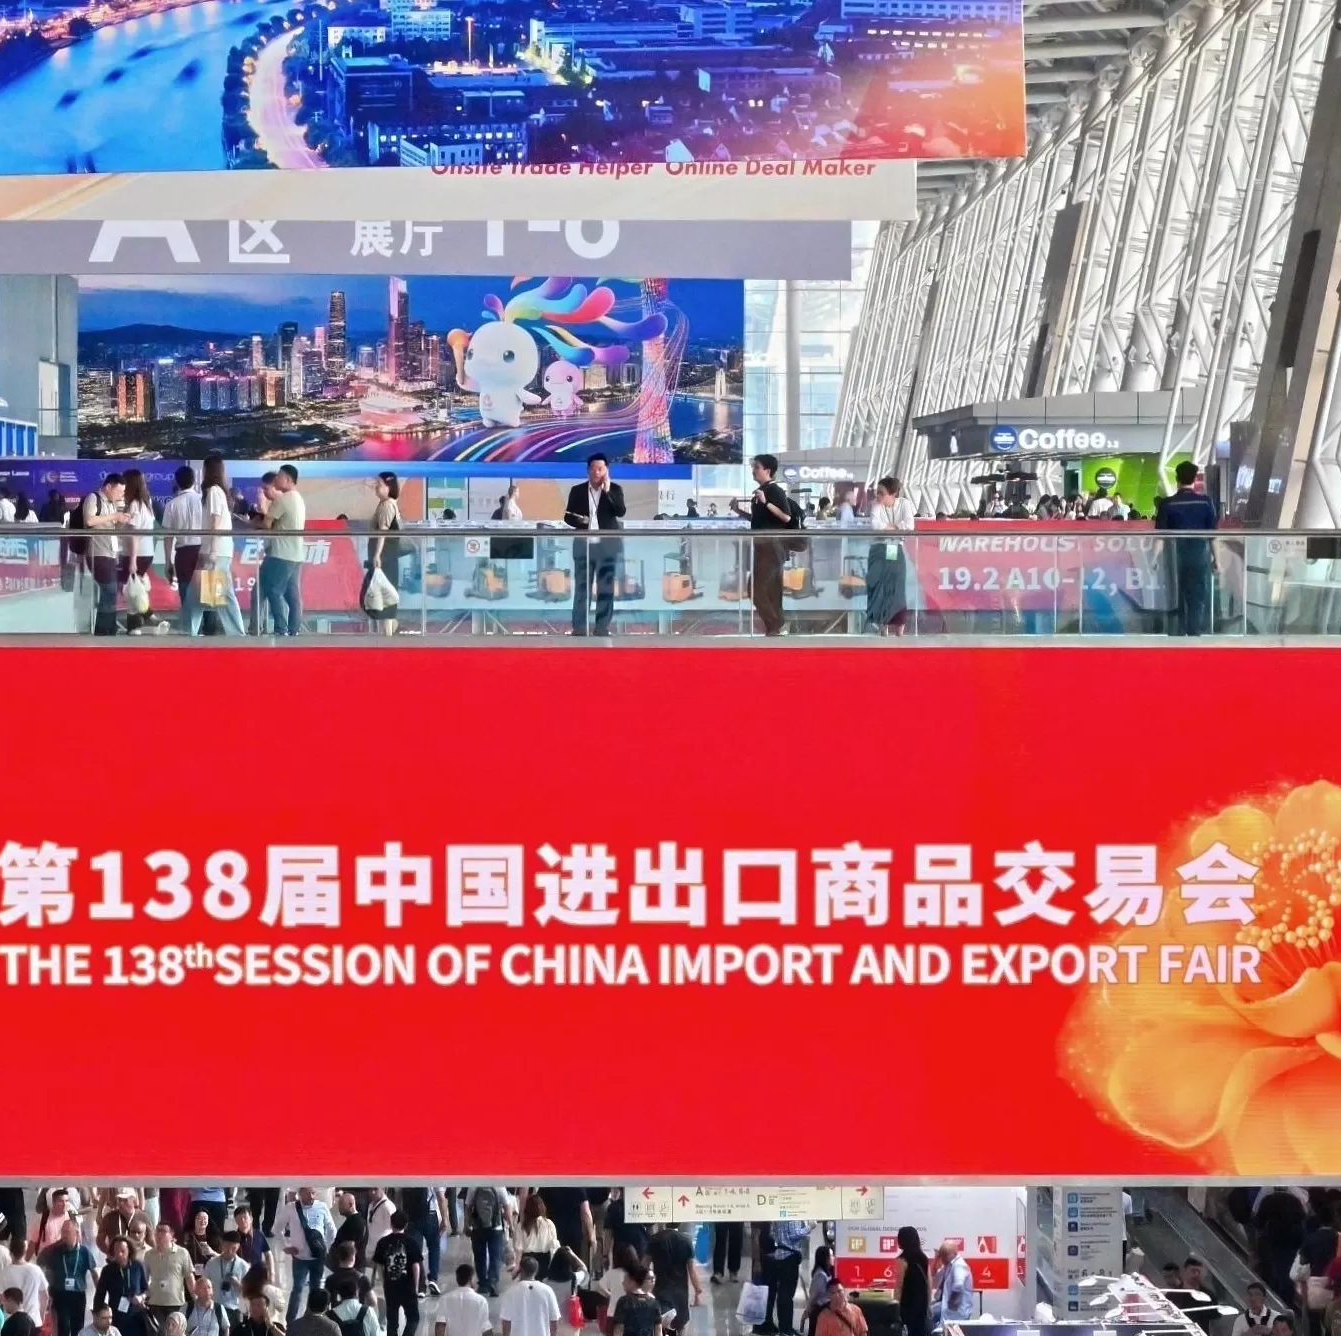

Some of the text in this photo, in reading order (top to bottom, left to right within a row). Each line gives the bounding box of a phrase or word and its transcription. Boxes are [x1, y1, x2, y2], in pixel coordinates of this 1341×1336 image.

[578, 160, 653, 180] Helper
[666, 160, 738, 176] Online
[745, 159, 795, 176] Deal
[803, 159, 877, 176] Maker
[1018, 428, 1106, 449] Coffee
[799, 466, 847, 479] Coffee
[938, 536, 1083, 552] WAREHOUS
[938, 566, 999, 590] 19.2
[426, 943, 492, 986] OF
[501, 943, 649, 986] CHINA
[660, 943, 843, 986] IMPORT
[851, 943, 950, 986] AND
[962, 943, 1148, 986] EXPORT
[1159, 943, 1262, 986] FAIR
